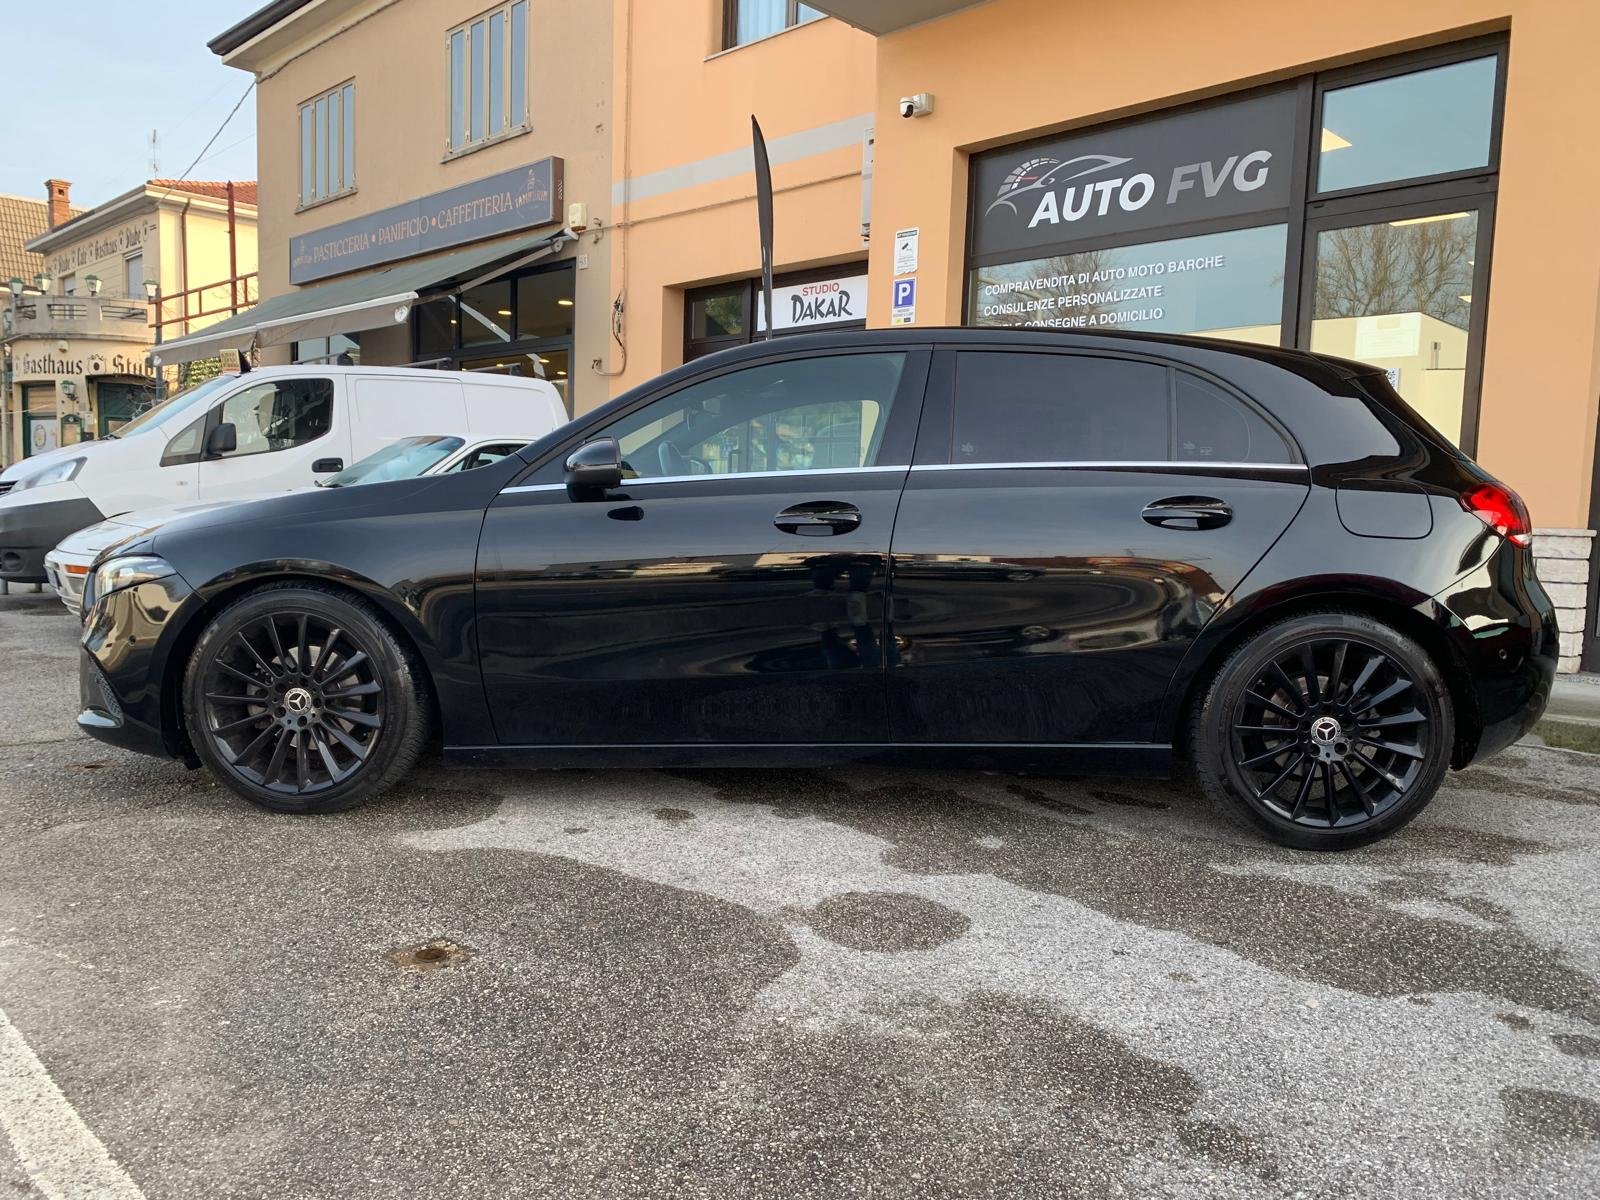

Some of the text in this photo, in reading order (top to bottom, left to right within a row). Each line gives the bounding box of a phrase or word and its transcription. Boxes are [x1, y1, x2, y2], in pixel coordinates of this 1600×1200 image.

[1027, 150, 1273, 228] AUTO FVG
[313, 231, 370, 263] PASTICCERIA
[378, 215, 430, 246] PANIFICIO
[437, 191, 513, 229] CAFFETTERIA
[802, 282, 840, 297] STUDIO
[985, 255, 1223, 297] COMPRAVENDITA DI AUTO MOTO BARCHE
[790, 290, 853, 324] DAKAR
[897, 283, 911, 305] P
[984, 285, 1163, 317] CONSULENZE PERSONALIZZATE
[1089, 315, 1097, 326] A
[1100, 307, 1163, 324] DOMICILIO
[23, 352, 83, 375] Gasthaus
